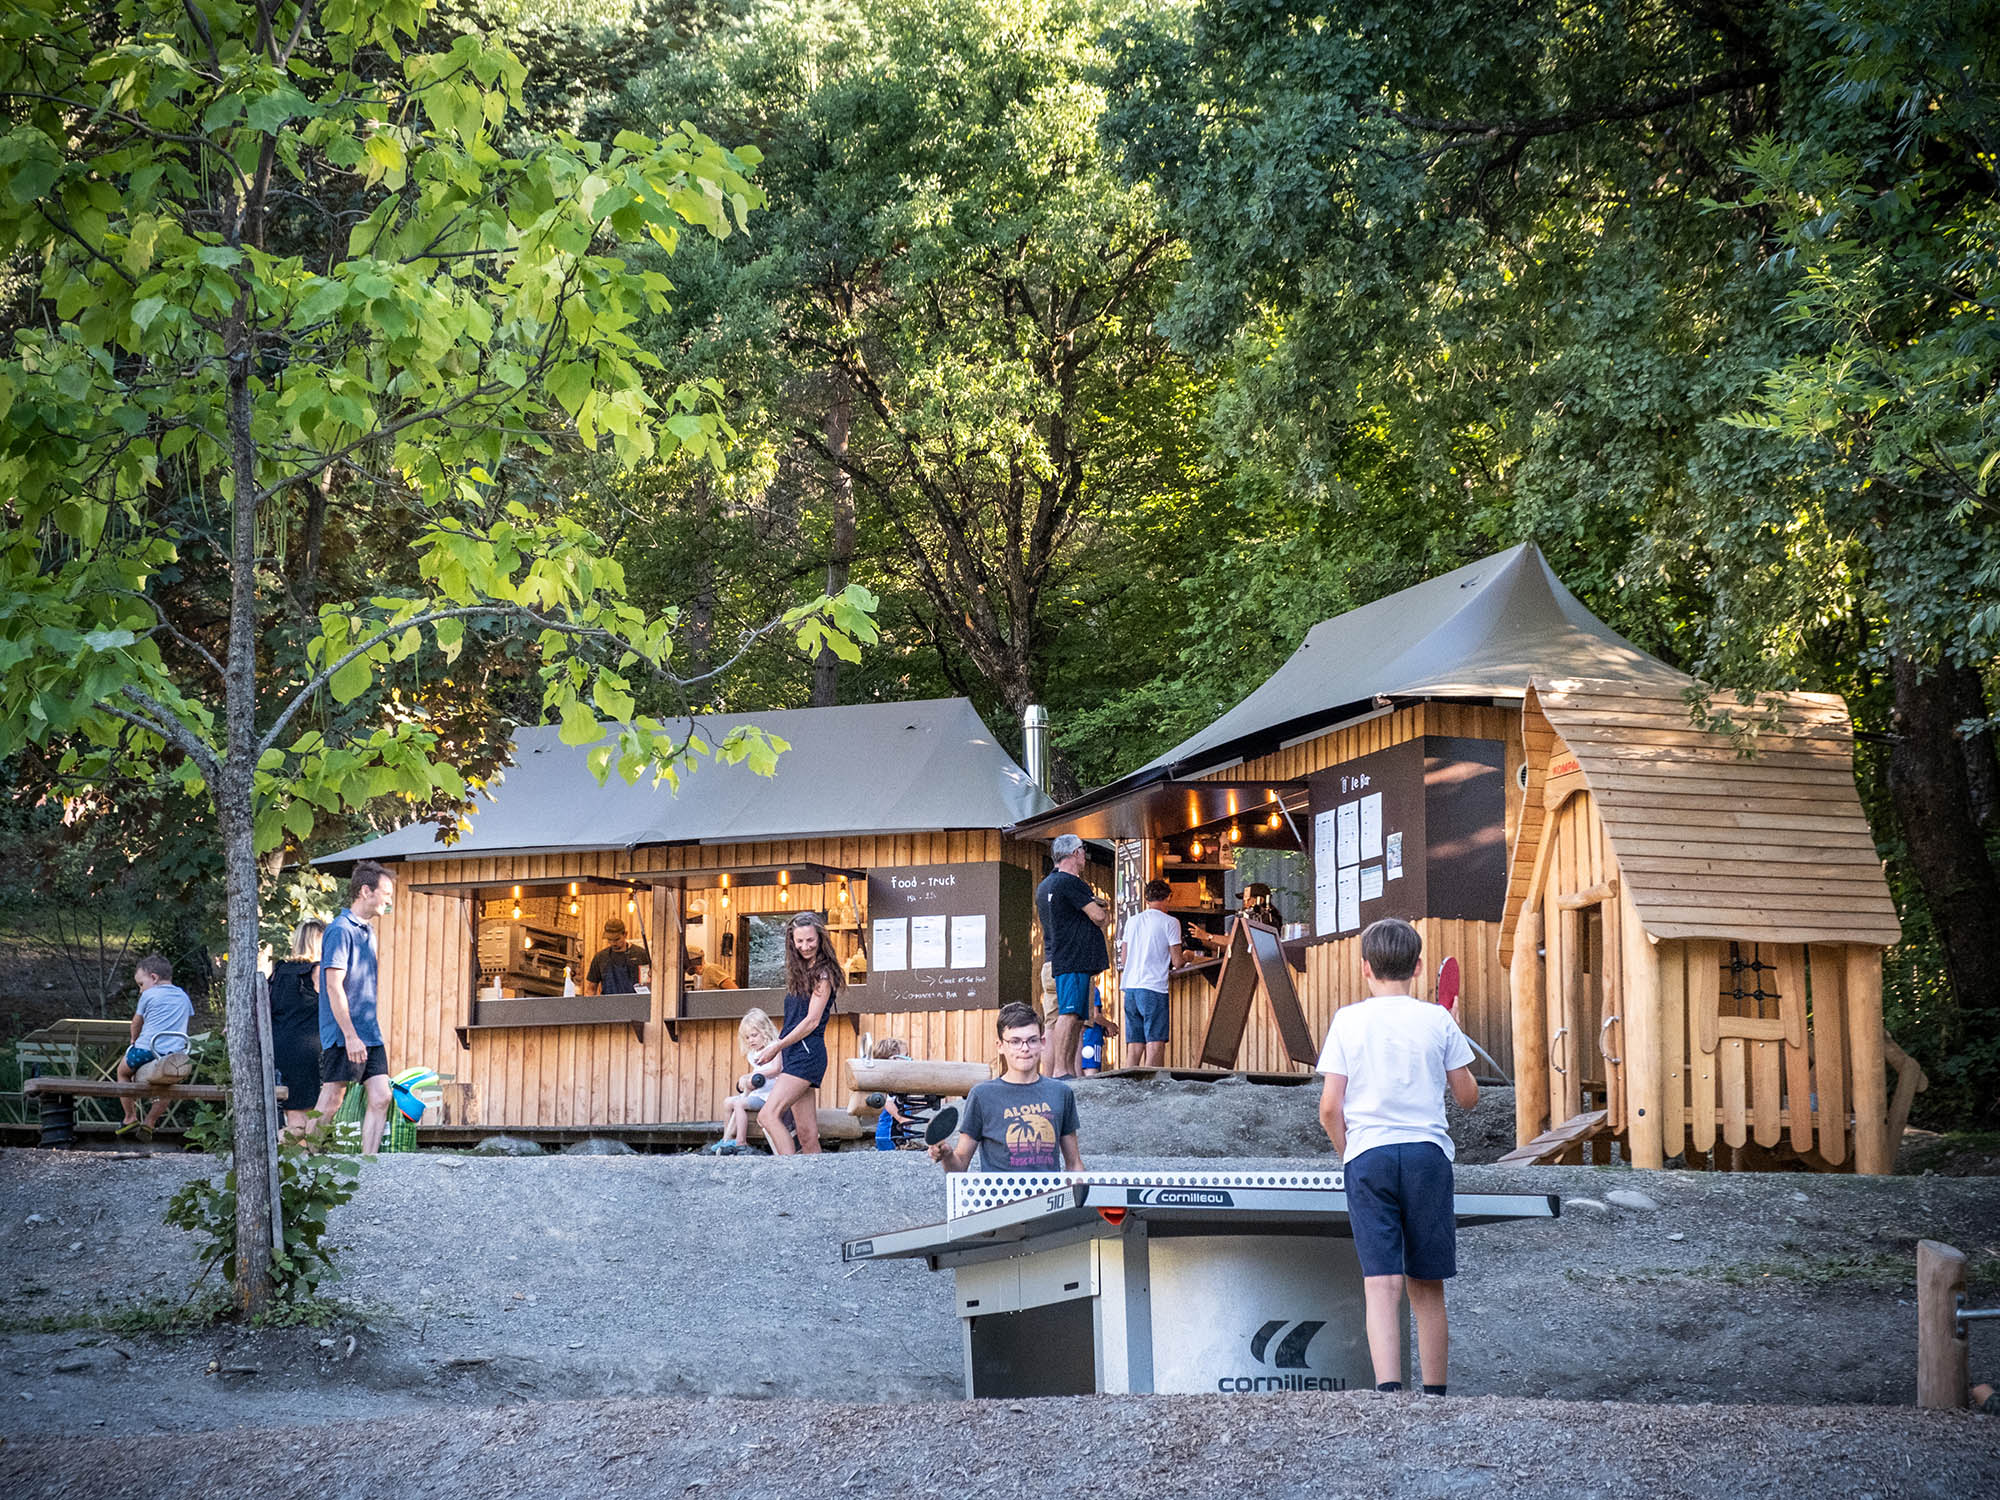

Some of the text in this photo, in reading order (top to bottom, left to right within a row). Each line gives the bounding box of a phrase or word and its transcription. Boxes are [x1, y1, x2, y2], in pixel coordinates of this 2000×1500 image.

[1003, 1102, 1052, 1120] ALOHA
[1046, 1193, 1065, 1213] 510
[1161, 1191, 1224, 1204] cornilleau
[1218, 1374, 1346, 1393] cornilleau
